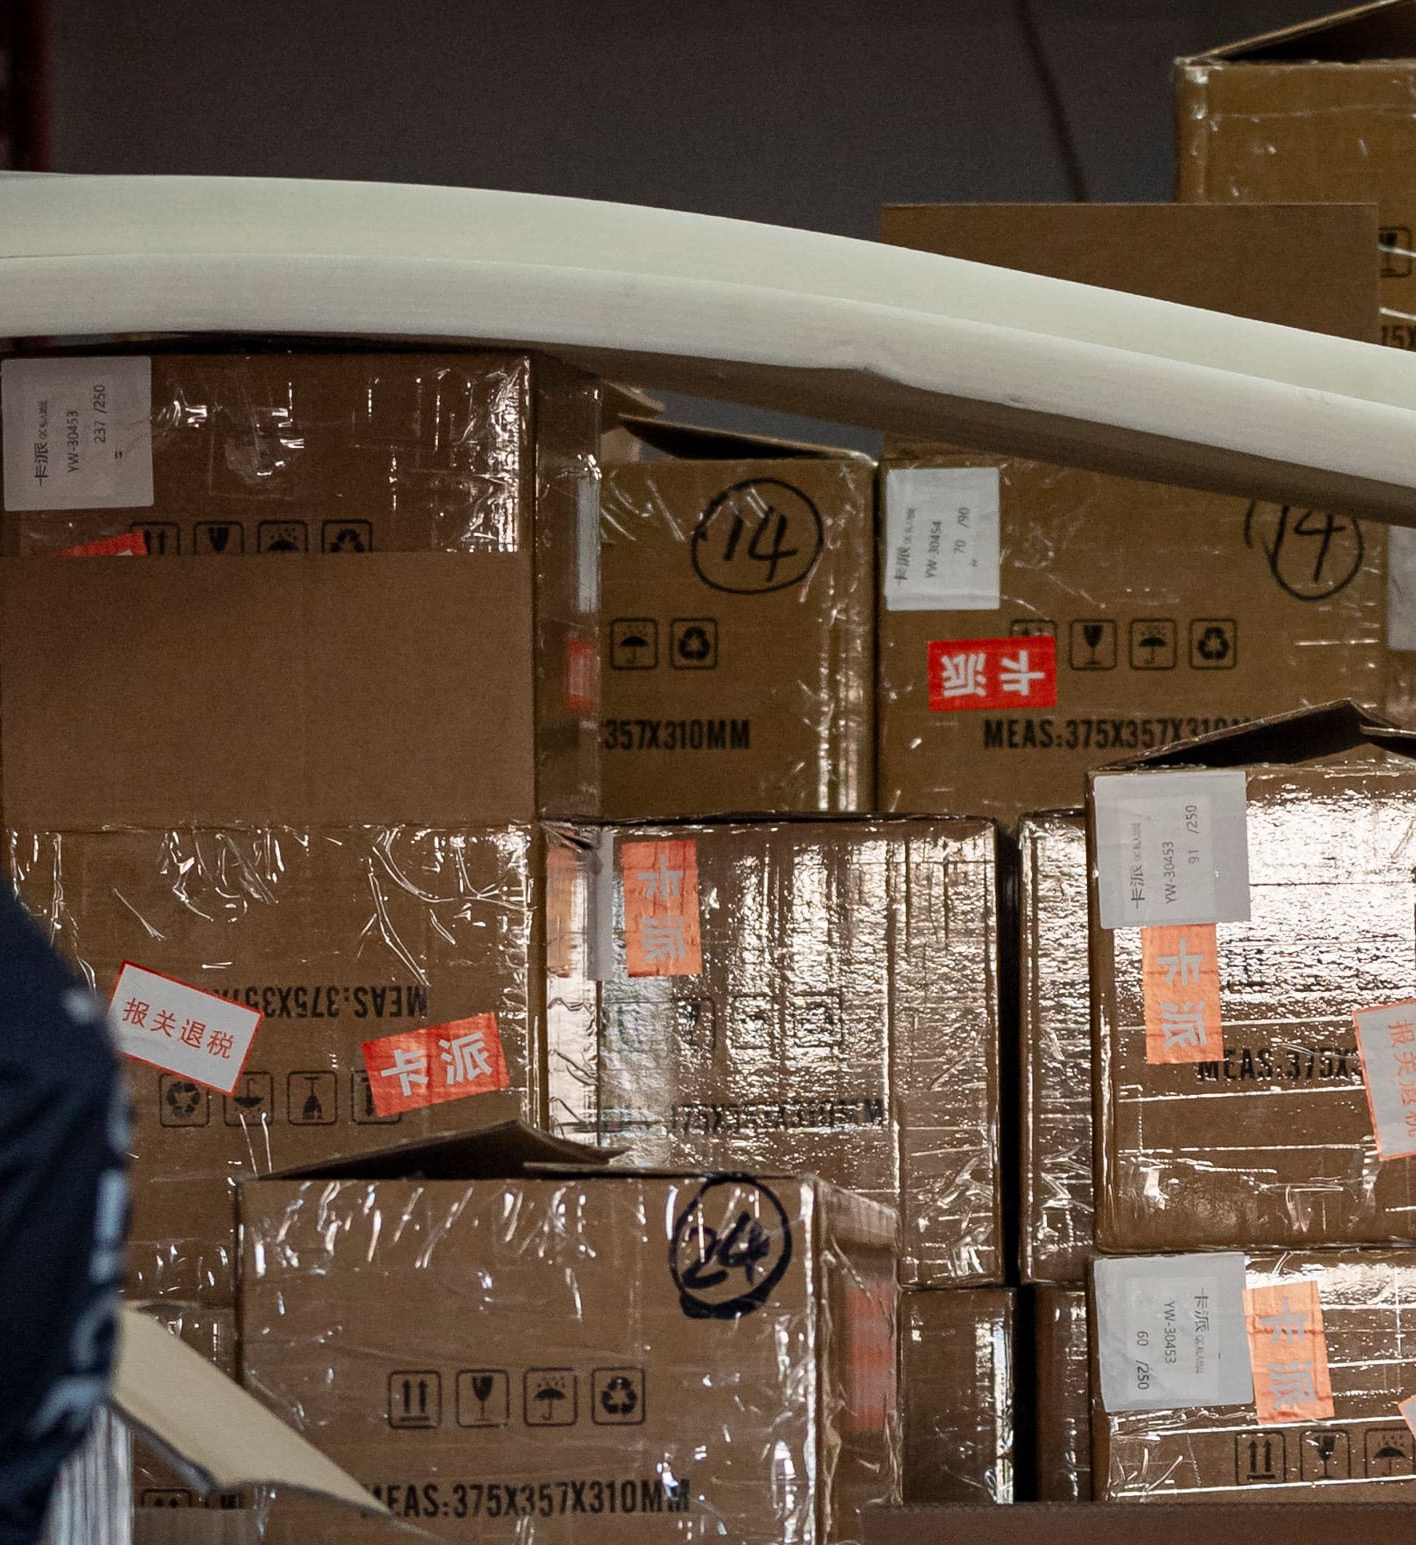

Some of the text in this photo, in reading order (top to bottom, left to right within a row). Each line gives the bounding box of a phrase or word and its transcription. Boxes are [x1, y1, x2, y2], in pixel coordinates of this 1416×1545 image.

[68, 409, 80, 473] YW-30453
[93, 383, 106, 444] 237 /250
[953, 506, 970, 554] 70 /90
[941, 650, 1045, 698] 卡派
[1185, 803, 1200, 865] 91 /250
[1162, 840, 1177, 905] YW-30453
[637, 852, 687, 963] 卡派
[1156, 938, 1209, 1050] 卡派
[122, 996, 235, 1061] 报关退税
[381, 1032, 493, 1097] 卡派
[1164, 1300, 1176, 1365] YW-30453
[1193, 1288, 1210, 1332] 卡派
[1135, 1330, 1150, 1391] 60 /250
[1260, 1296, 1317, 1412] 卡派
